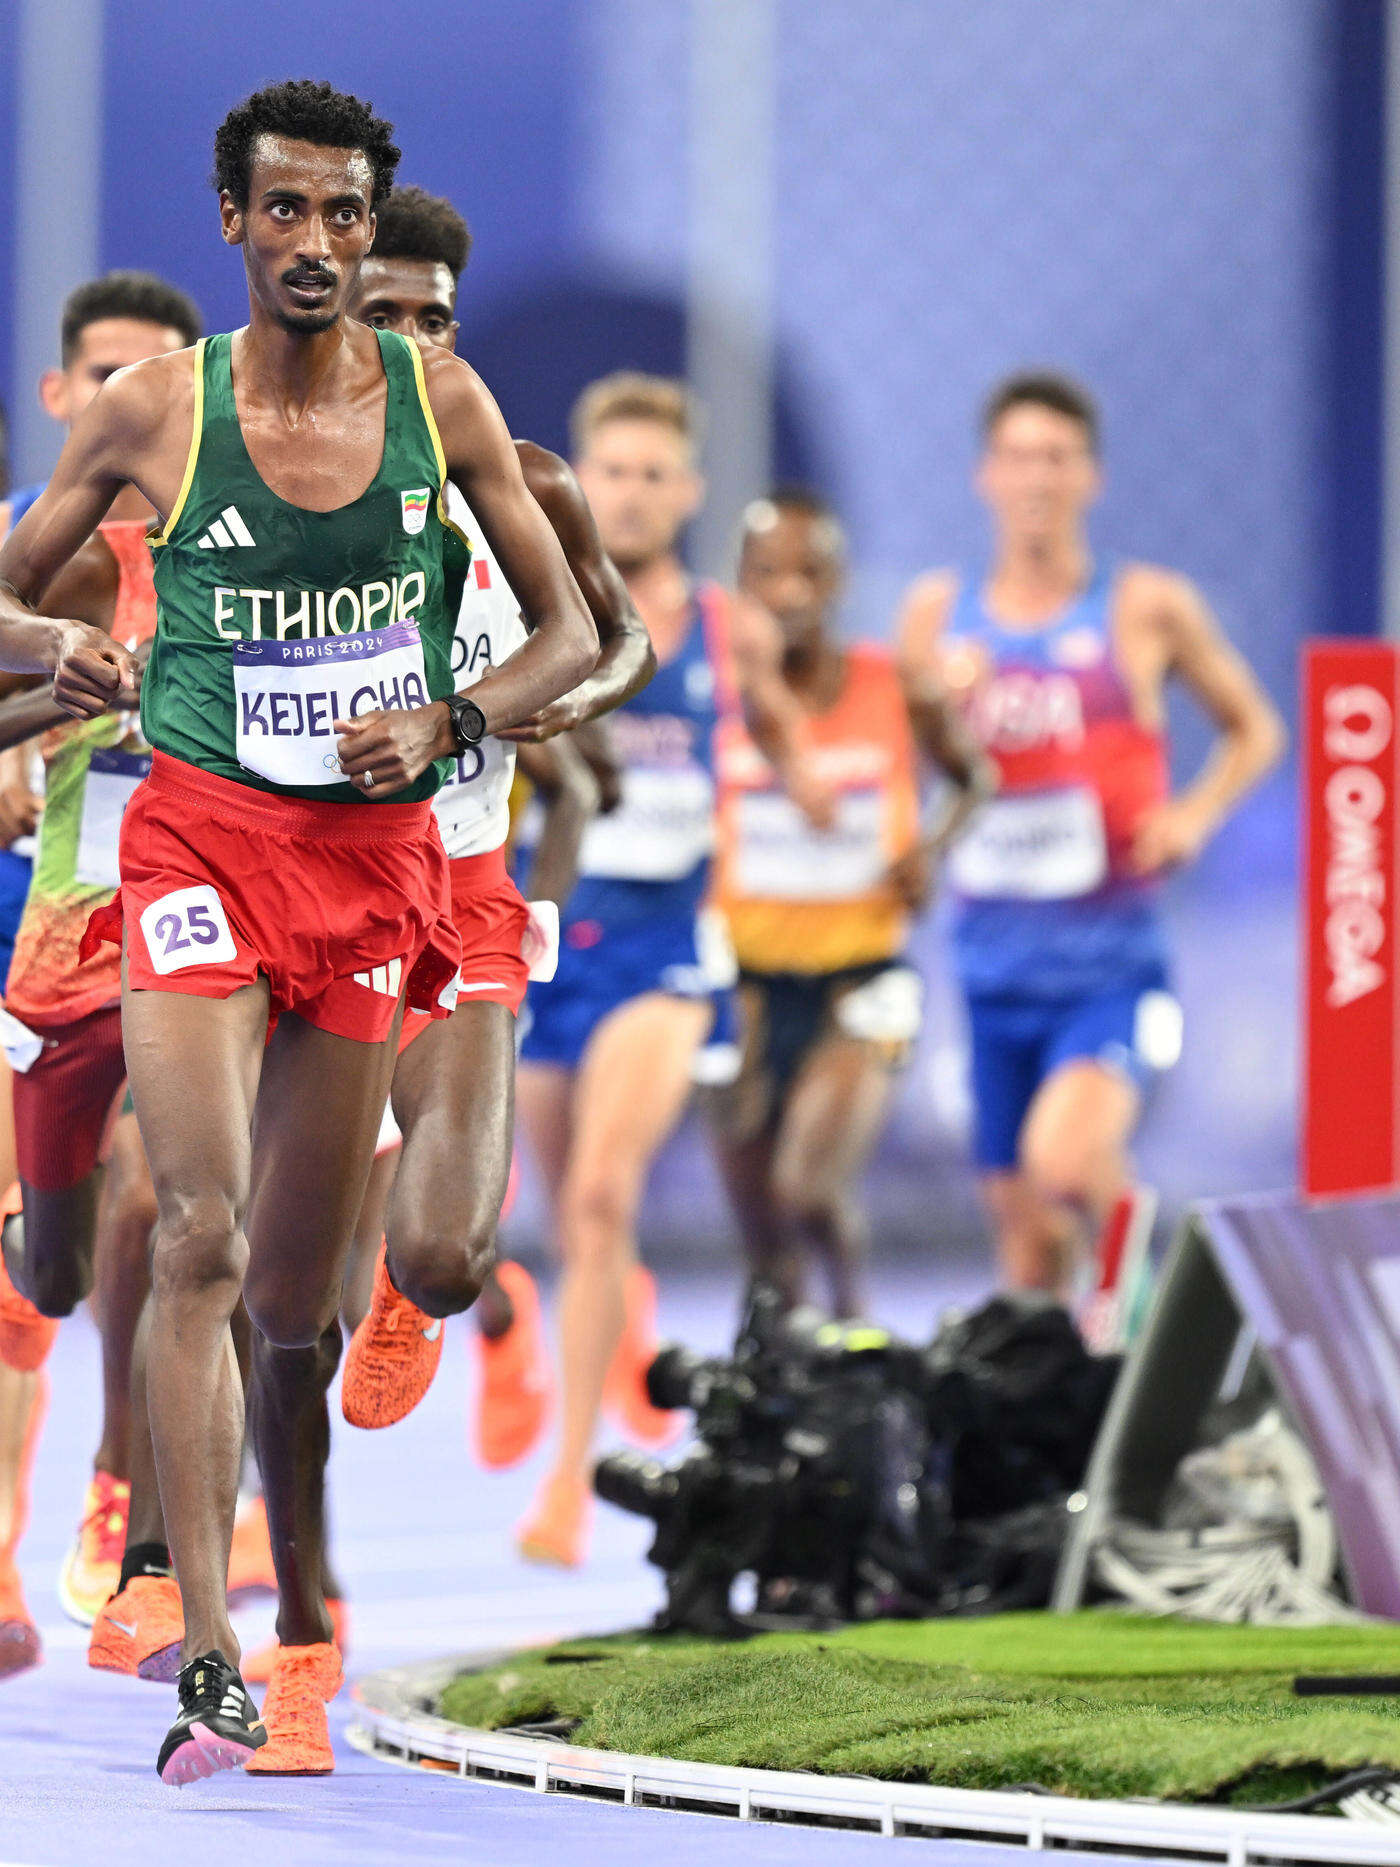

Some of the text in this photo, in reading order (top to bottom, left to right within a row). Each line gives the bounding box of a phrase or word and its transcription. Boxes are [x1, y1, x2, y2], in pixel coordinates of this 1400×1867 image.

[214, 571, 426, 642] ETHIOPIA
[282, 637, 383, 660] PARIS 2024
[241, 671, 427, 738] KEJELCHA
[1324, 764, 1387, 1009] OMEGA
[154, 905, 220, 956] 25
